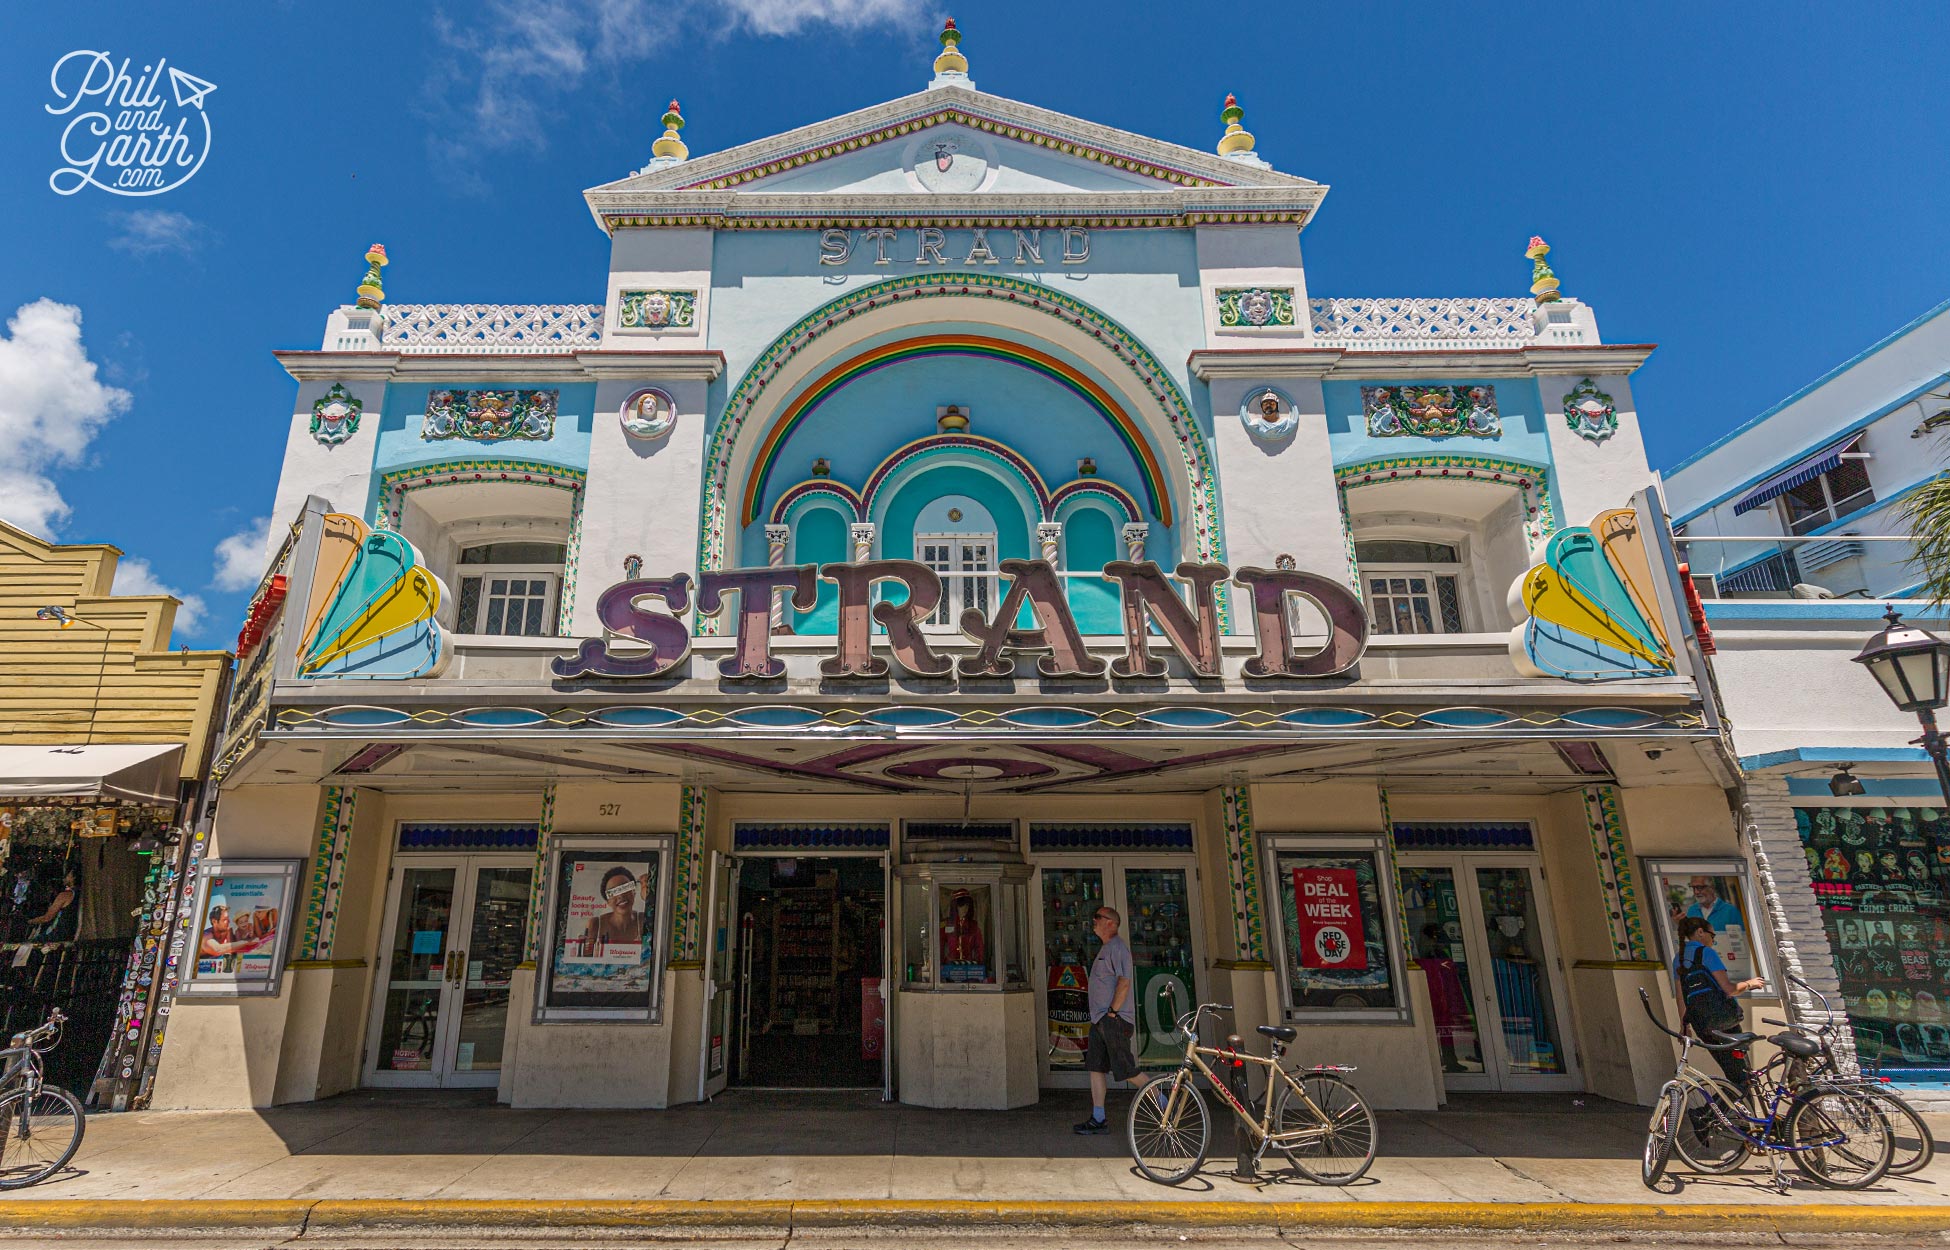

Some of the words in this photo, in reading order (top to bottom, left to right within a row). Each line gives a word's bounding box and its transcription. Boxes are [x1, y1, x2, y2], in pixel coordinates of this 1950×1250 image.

[819, 225, 1091, 265] STRAND
[550, 558, 1371, 681] STRAND
[599, 803, 621, 816] 527
[1303, 883, 1349, 896] DEAL
[572, 894, 595, 902] Beauty
[1304, 903, 1352, 917] WEEK
[1859, 904, 1885, 913] CRIME
[1322, 932, 1342, 940] RED
[1324, 949, 1343, 958] DAY
[1901, 955, 1930, 964] BEAST
